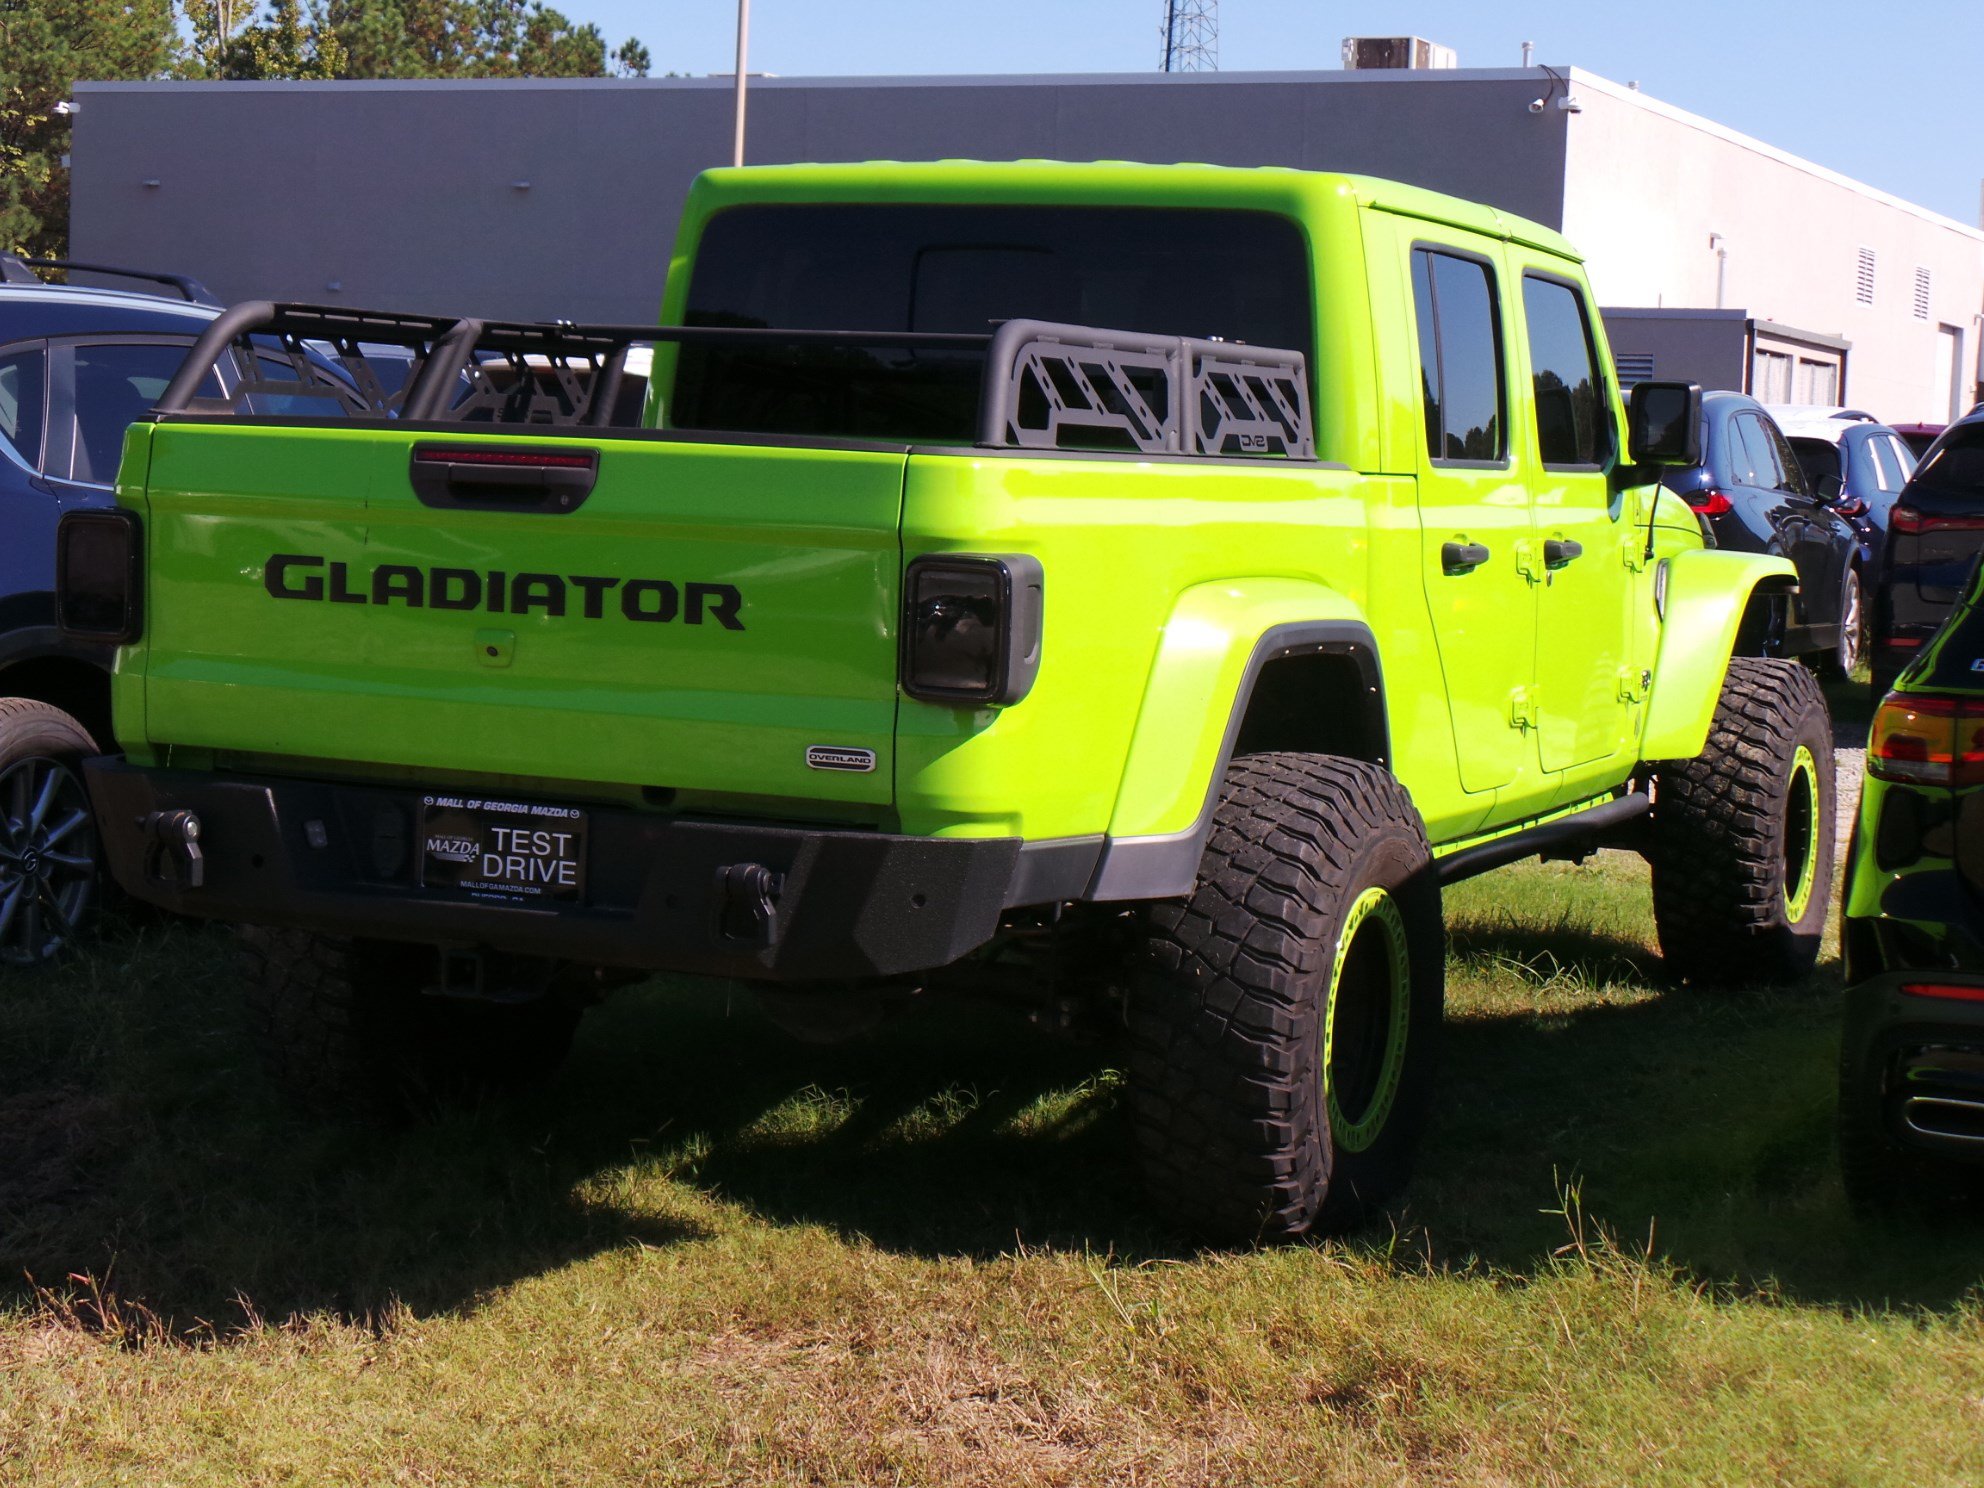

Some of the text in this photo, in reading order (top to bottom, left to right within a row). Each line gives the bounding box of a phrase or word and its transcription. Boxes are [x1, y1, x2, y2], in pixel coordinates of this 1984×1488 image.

[265, 554, 745, 630] GLADIATOR
[809, 753, 871, 763] OVERLAND
[436, 797, 568, 818] MALL OF GEORGIA MAZDA
[426, 838, 480, 855] MAZDA
[491, 828, 572, 857] TEST
[483, 853, 577, 885] DRIVE
